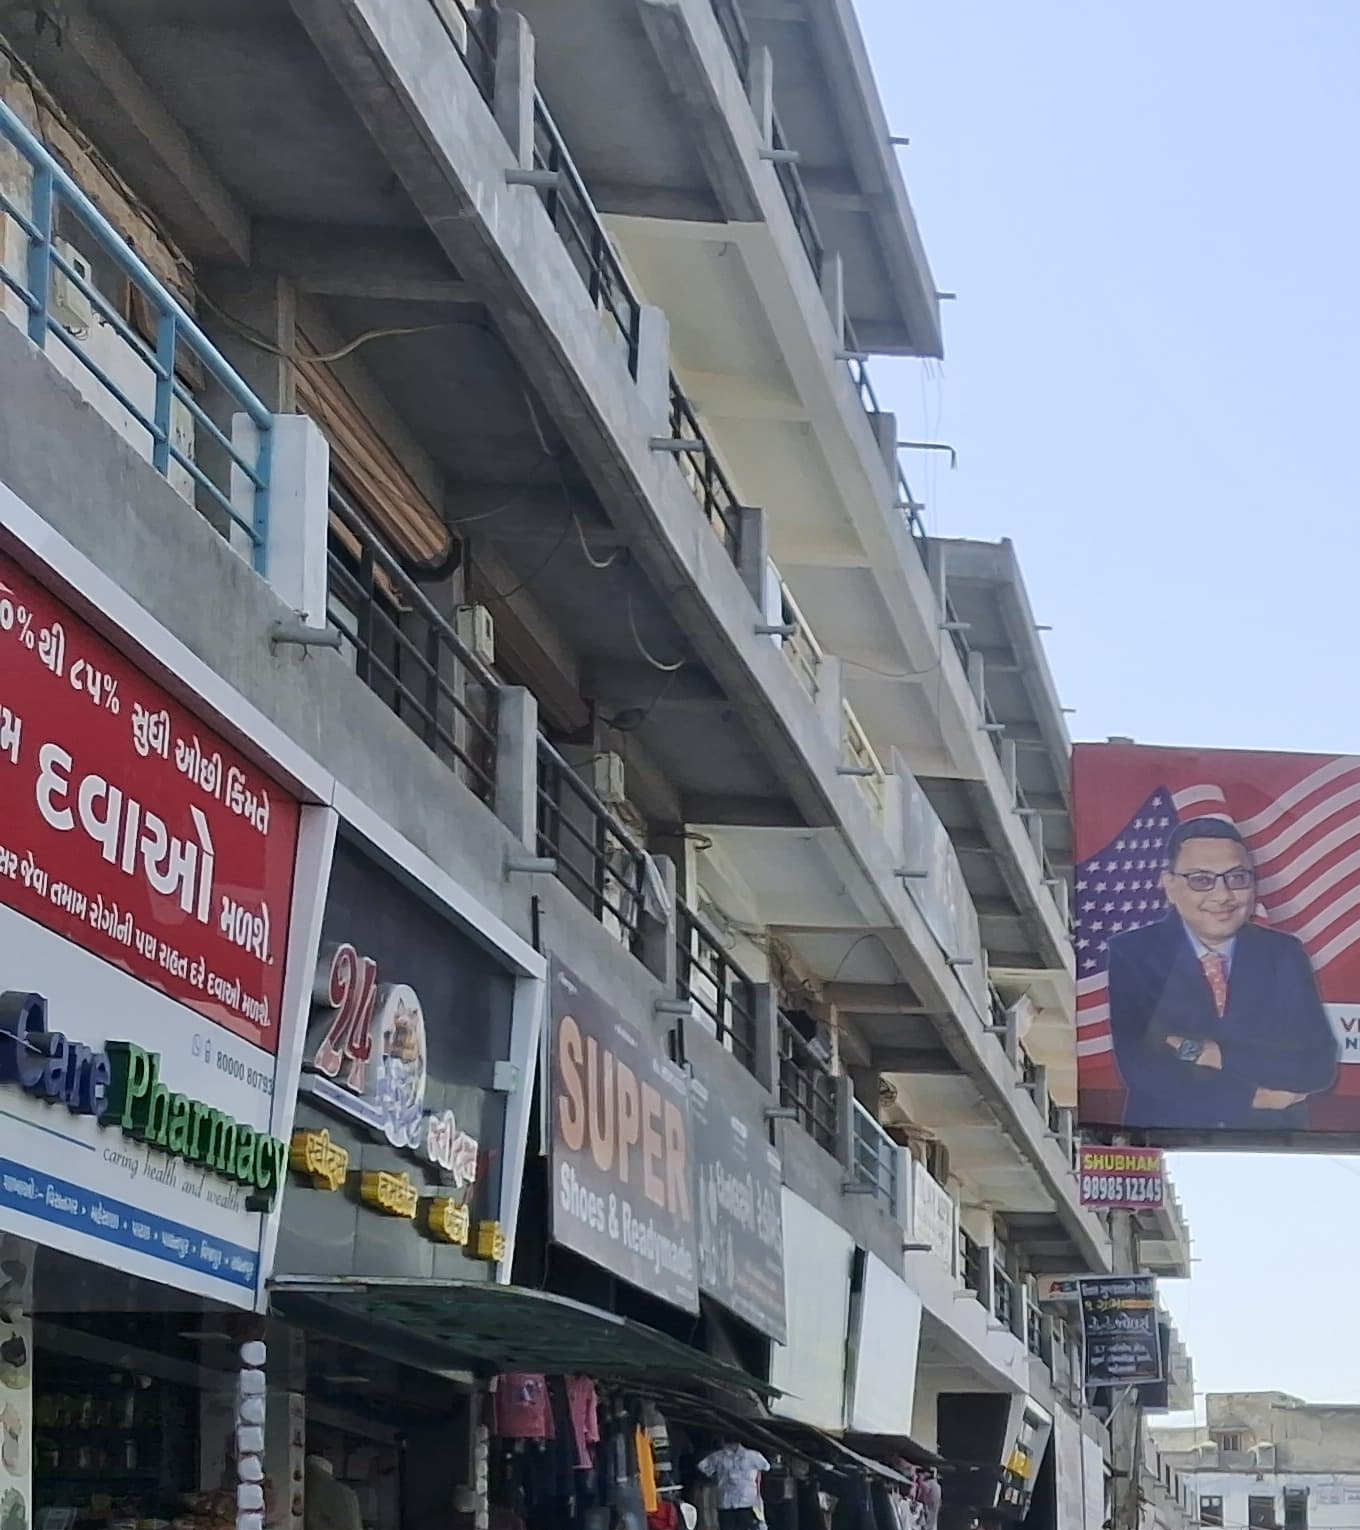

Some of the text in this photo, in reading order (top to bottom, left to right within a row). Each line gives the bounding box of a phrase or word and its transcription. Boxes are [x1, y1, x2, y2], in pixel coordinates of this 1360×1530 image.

[38, 622, 65, 676] થી
[131, 702, 170, 759] સુધી
[175, 735, 222, 800] ઓછી
[226, 766, 270, 834] કિંમતે
[35, 743, 215, 924] દવાઓ
[20, 850, 48, 897] જેવા
[50, 881, 88, 921] તમામ
[89, 893, 134, 947] રોગોની
[136, 927, 157, 961] પણ
[159, 943, 189, 979] રાહત
[190, 956, 205, 989] દરે
[207, 972, 241, 1011] દવાઓ
[0, 988, 112, 1114] Care
[108, 1040, 290, 1214] Pharmacy
[102, 1147, 139, 1179] caring
[143, 1151, 177, 1189] health
[182, 1170, 206, 1200] and
[559, 1015, 691, 1223] SUPER
[1083, 1154, 1160, 1172] SHUBHAM
[560, 1161, 605, 1233] Shoes
[608, 1192, 619, 1240] &
[1082, 1175, 1162, 1201] 98985 12345
